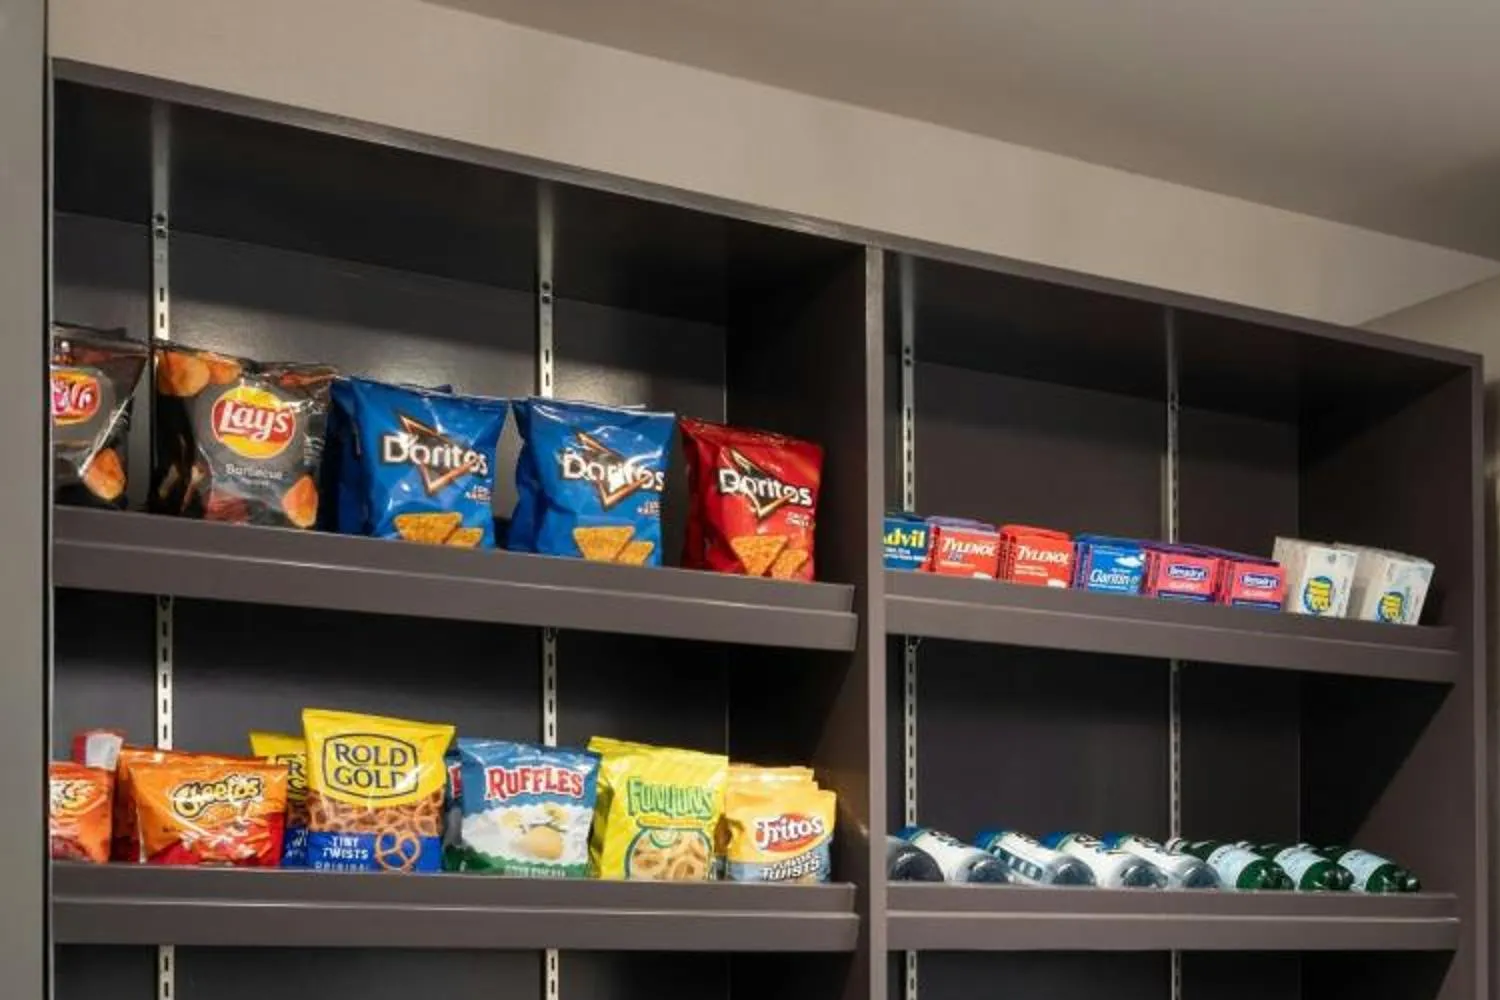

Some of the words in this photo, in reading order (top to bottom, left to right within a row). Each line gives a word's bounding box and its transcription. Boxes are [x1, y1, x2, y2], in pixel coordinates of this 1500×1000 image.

[383, 434, 488, 476] Doritos
[563, 453, 664, 492] Doritos
[720, 468, 812, 506] Doritos
[335, 743, 408, 767] ROLD
[334, 765, 409, 789] GOLD
[486, 767, 583, 799] RUFFLES
[755, 814, 825, 849] Fritos
[322, 847, 369, 860] TWISTS
